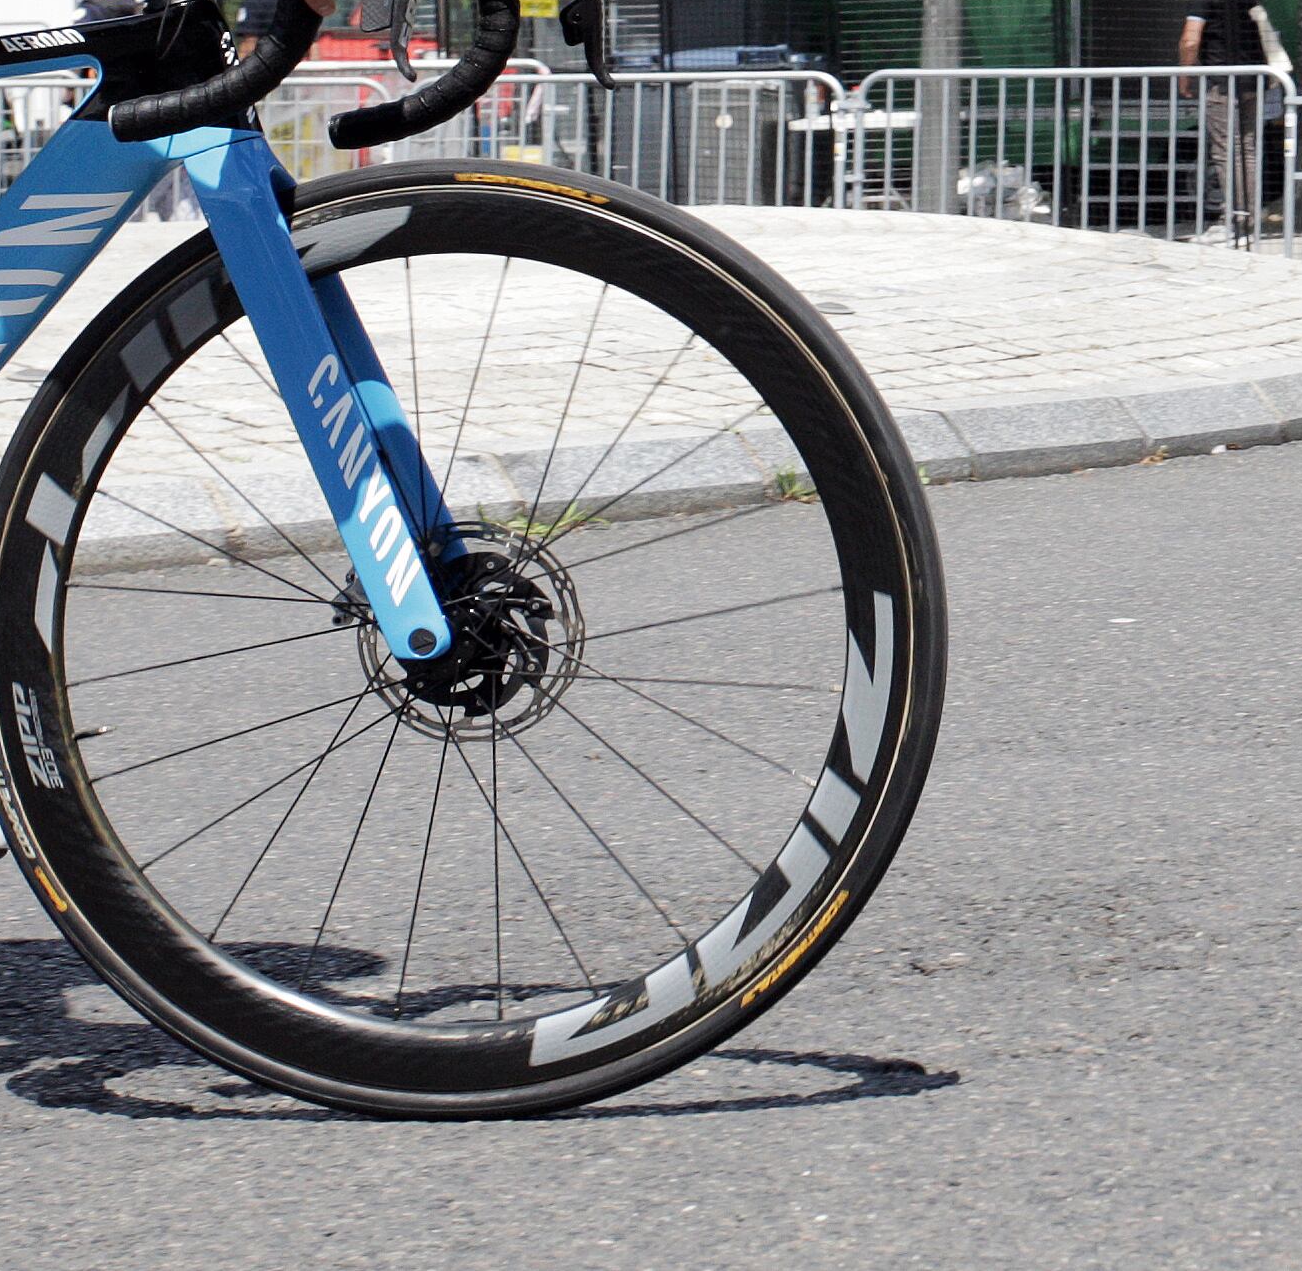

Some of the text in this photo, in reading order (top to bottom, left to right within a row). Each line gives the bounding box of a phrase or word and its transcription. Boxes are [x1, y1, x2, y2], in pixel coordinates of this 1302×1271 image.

[0, 28, 86, 53] AEROAD
[308, 353, 421, 607] CANYON
[12, 681, 51, 789] ZIPP
